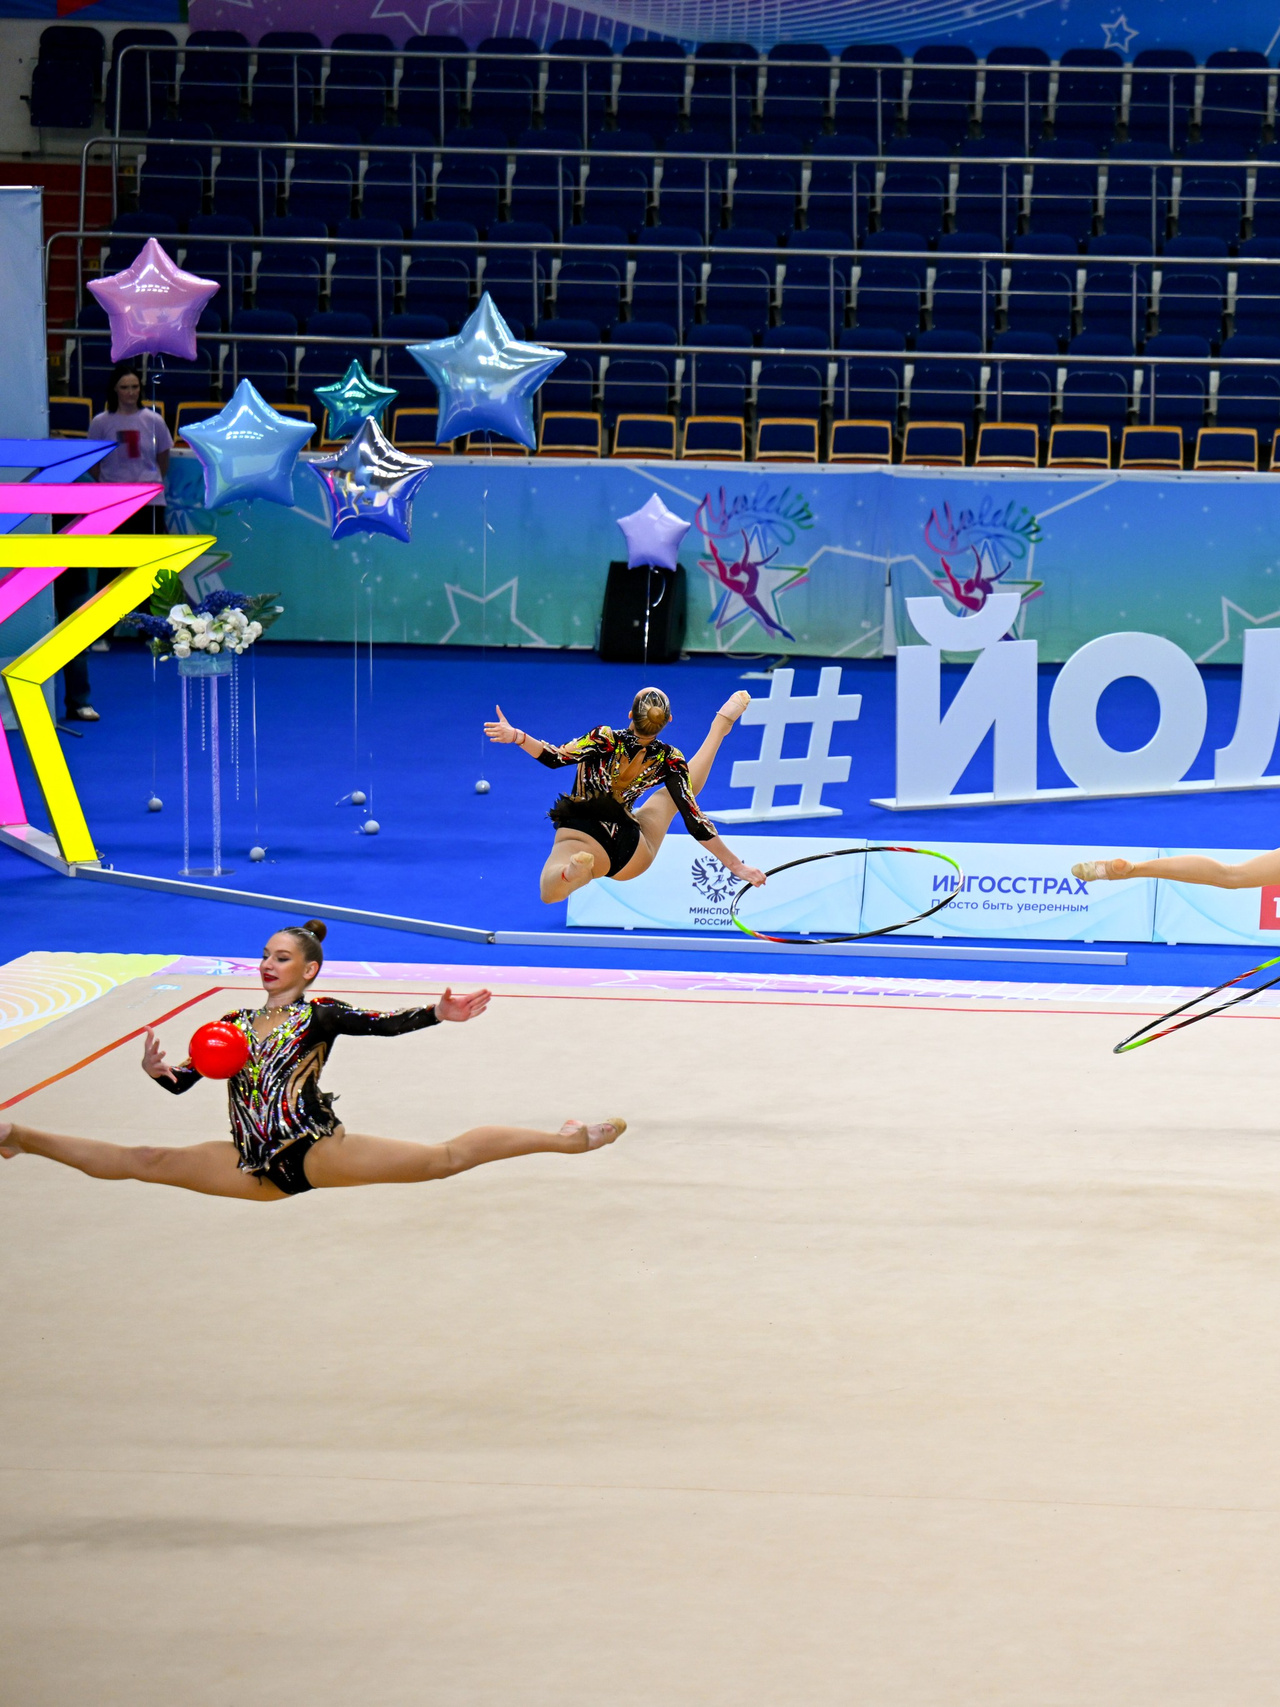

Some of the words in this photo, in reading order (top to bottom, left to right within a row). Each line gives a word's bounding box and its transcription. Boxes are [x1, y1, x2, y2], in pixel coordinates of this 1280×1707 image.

[932, 874, 1089, 895] ИНГОССТРАХ
[982, 900, 1013, 911] быть
[1017, 902, 1089, 914] уверенным
[694, 917, 733, 926] РОССИИ
